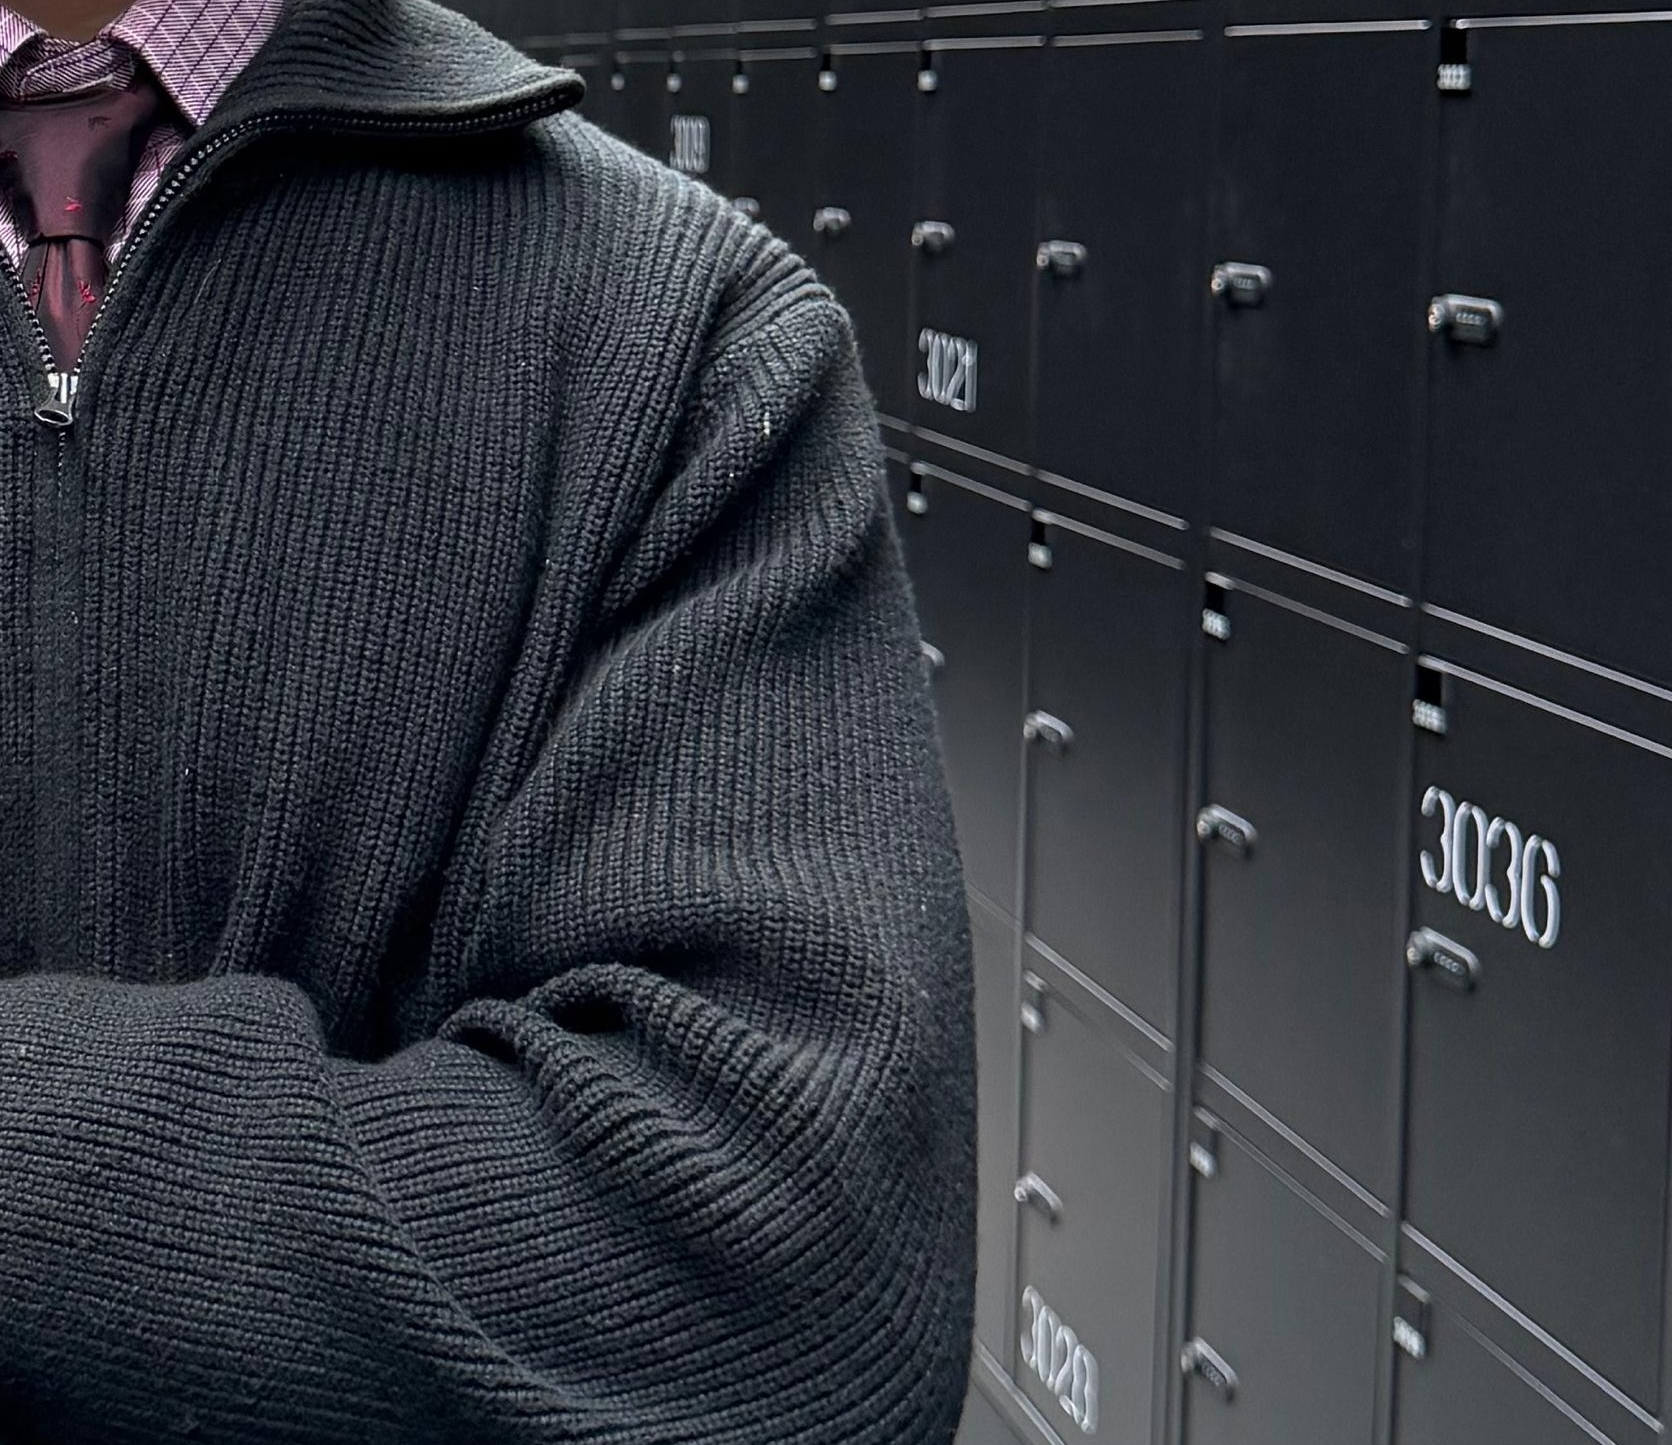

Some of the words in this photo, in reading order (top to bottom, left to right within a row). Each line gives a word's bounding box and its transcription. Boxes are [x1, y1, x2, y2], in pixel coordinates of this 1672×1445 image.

[917, 327, 978, 413] 3021
[1420, 785, 1561, 949] 3036
[1020, 1284, 1100, 1436] 3028
